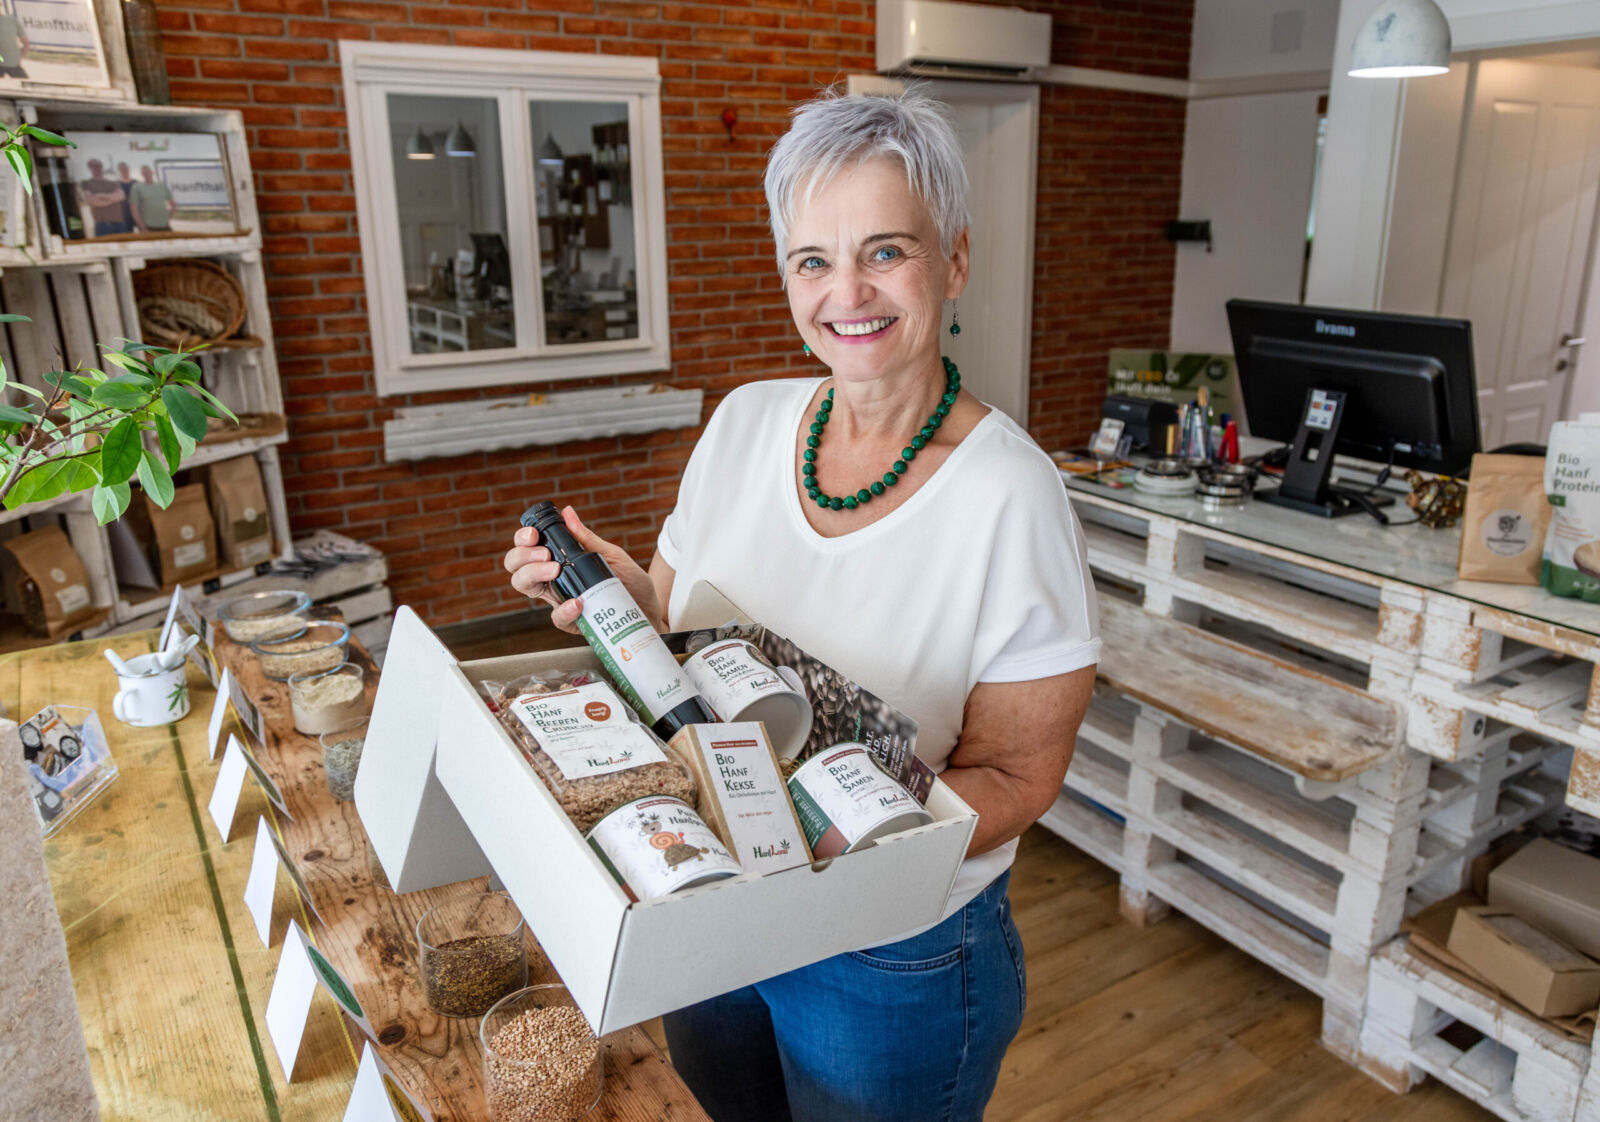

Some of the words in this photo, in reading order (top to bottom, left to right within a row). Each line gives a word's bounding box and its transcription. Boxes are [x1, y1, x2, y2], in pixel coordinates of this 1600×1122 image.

[1557, 453, 1580, 465] Bio
[1555, 466, 1591, 479] Hanf
[593, 607, 616, 625] Bio
[601, 607, 642, 637] Hanföl
